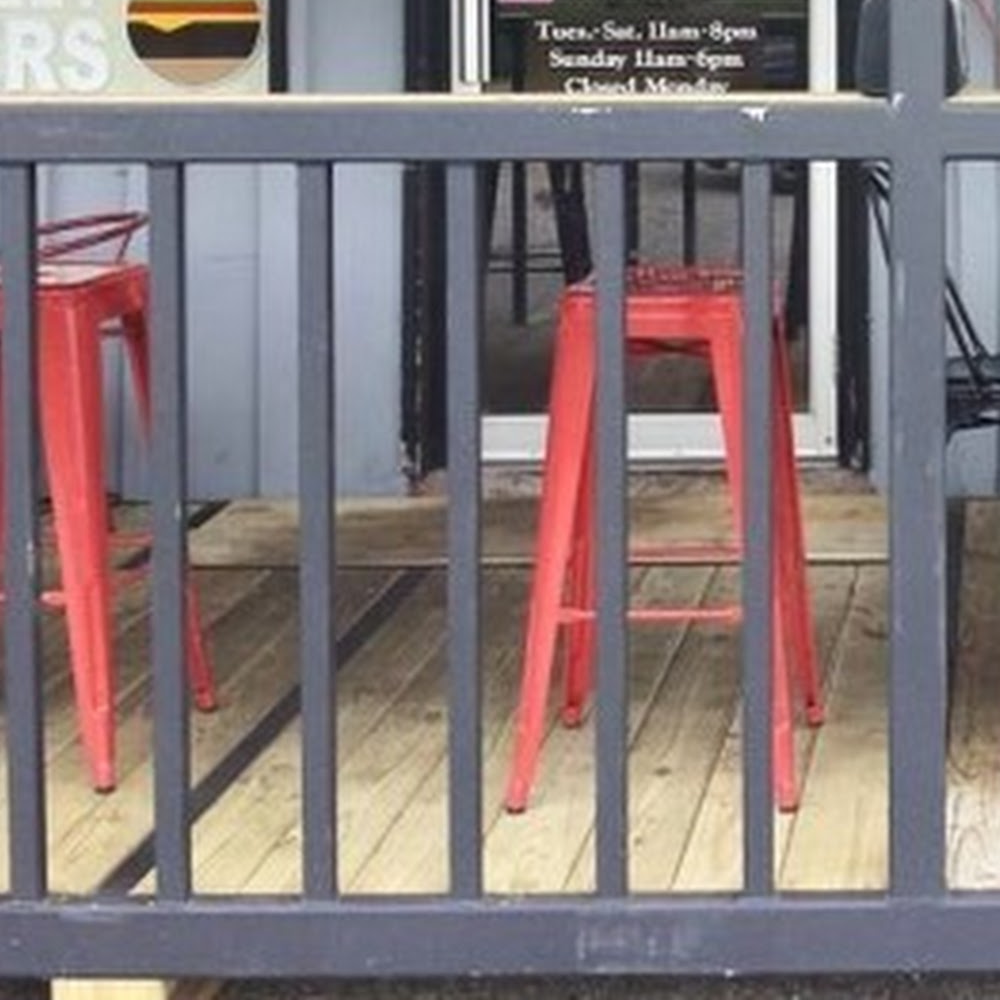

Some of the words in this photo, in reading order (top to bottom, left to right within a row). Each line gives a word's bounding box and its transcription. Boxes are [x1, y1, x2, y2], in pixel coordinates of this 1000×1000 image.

[548, 49, 628, 71] Sunday
[564, 76, 637, 94] Closed
[644, 76, 730, 94] Monday
